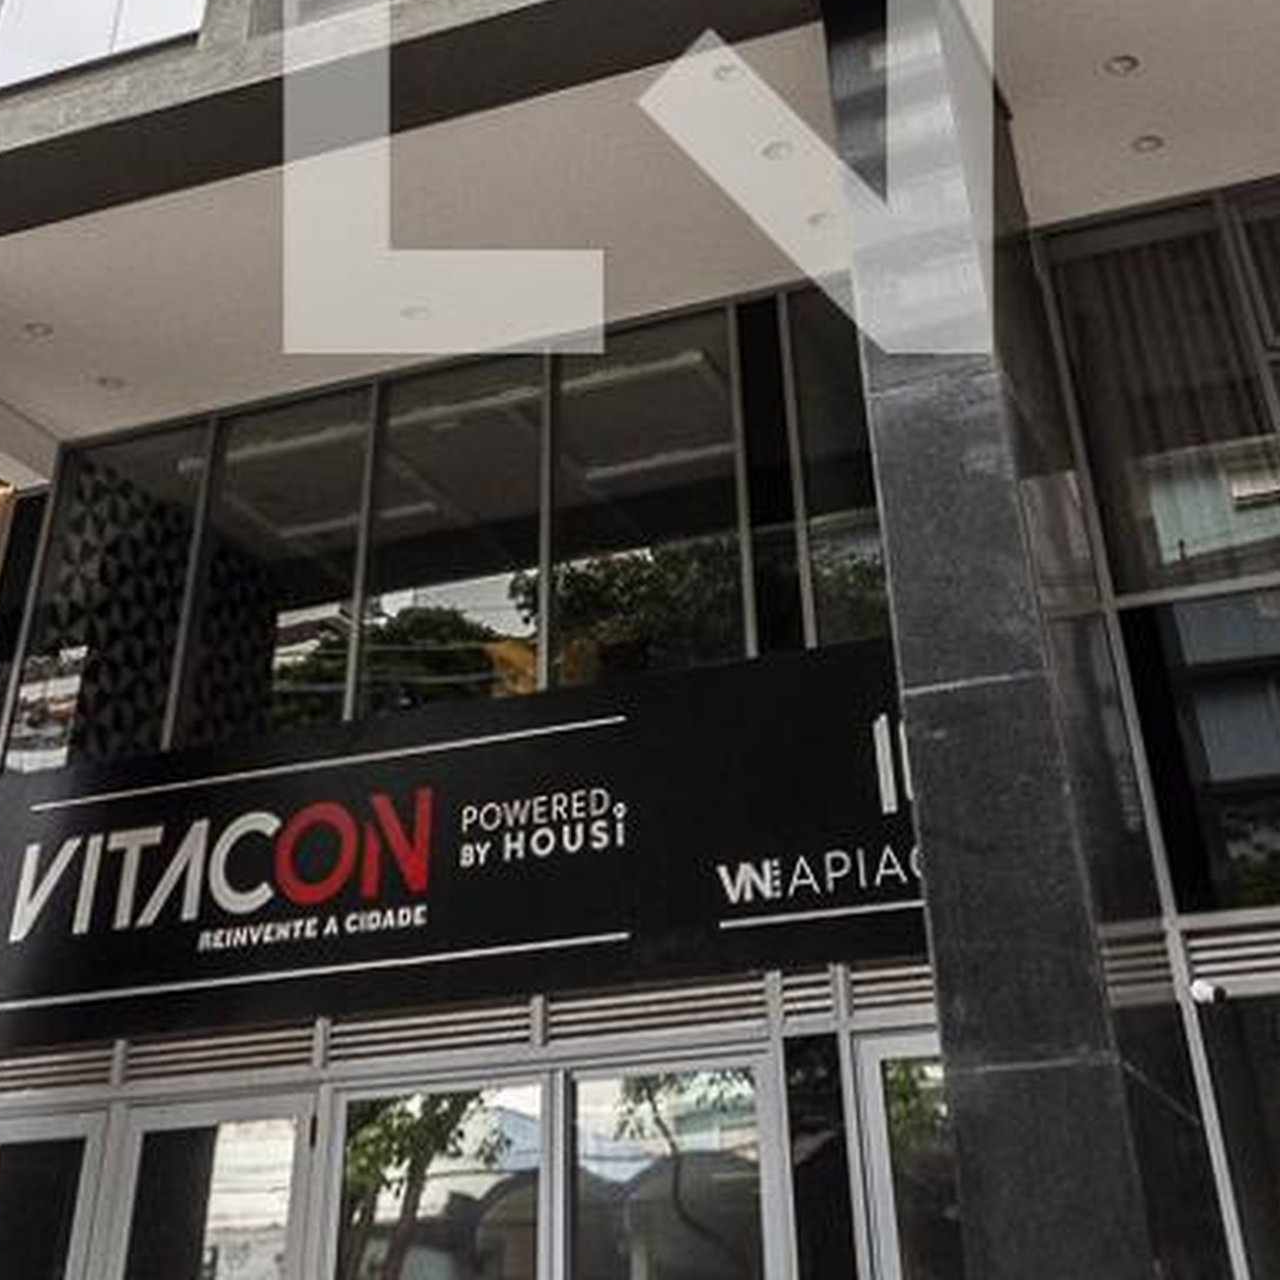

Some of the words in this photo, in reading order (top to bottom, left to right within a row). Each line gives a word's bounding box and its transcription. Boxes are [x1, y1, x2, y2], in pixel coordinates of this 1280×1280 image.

[461, 787, 610, 833] POWERED
[8, 786, 436, 944] VITACON
[459, 841, 492, 868] BY
[197, 916, 318, 952] REINVENTE
[323, 915, 339, 935] A
[344, 904, 428, 934] CIDADE
